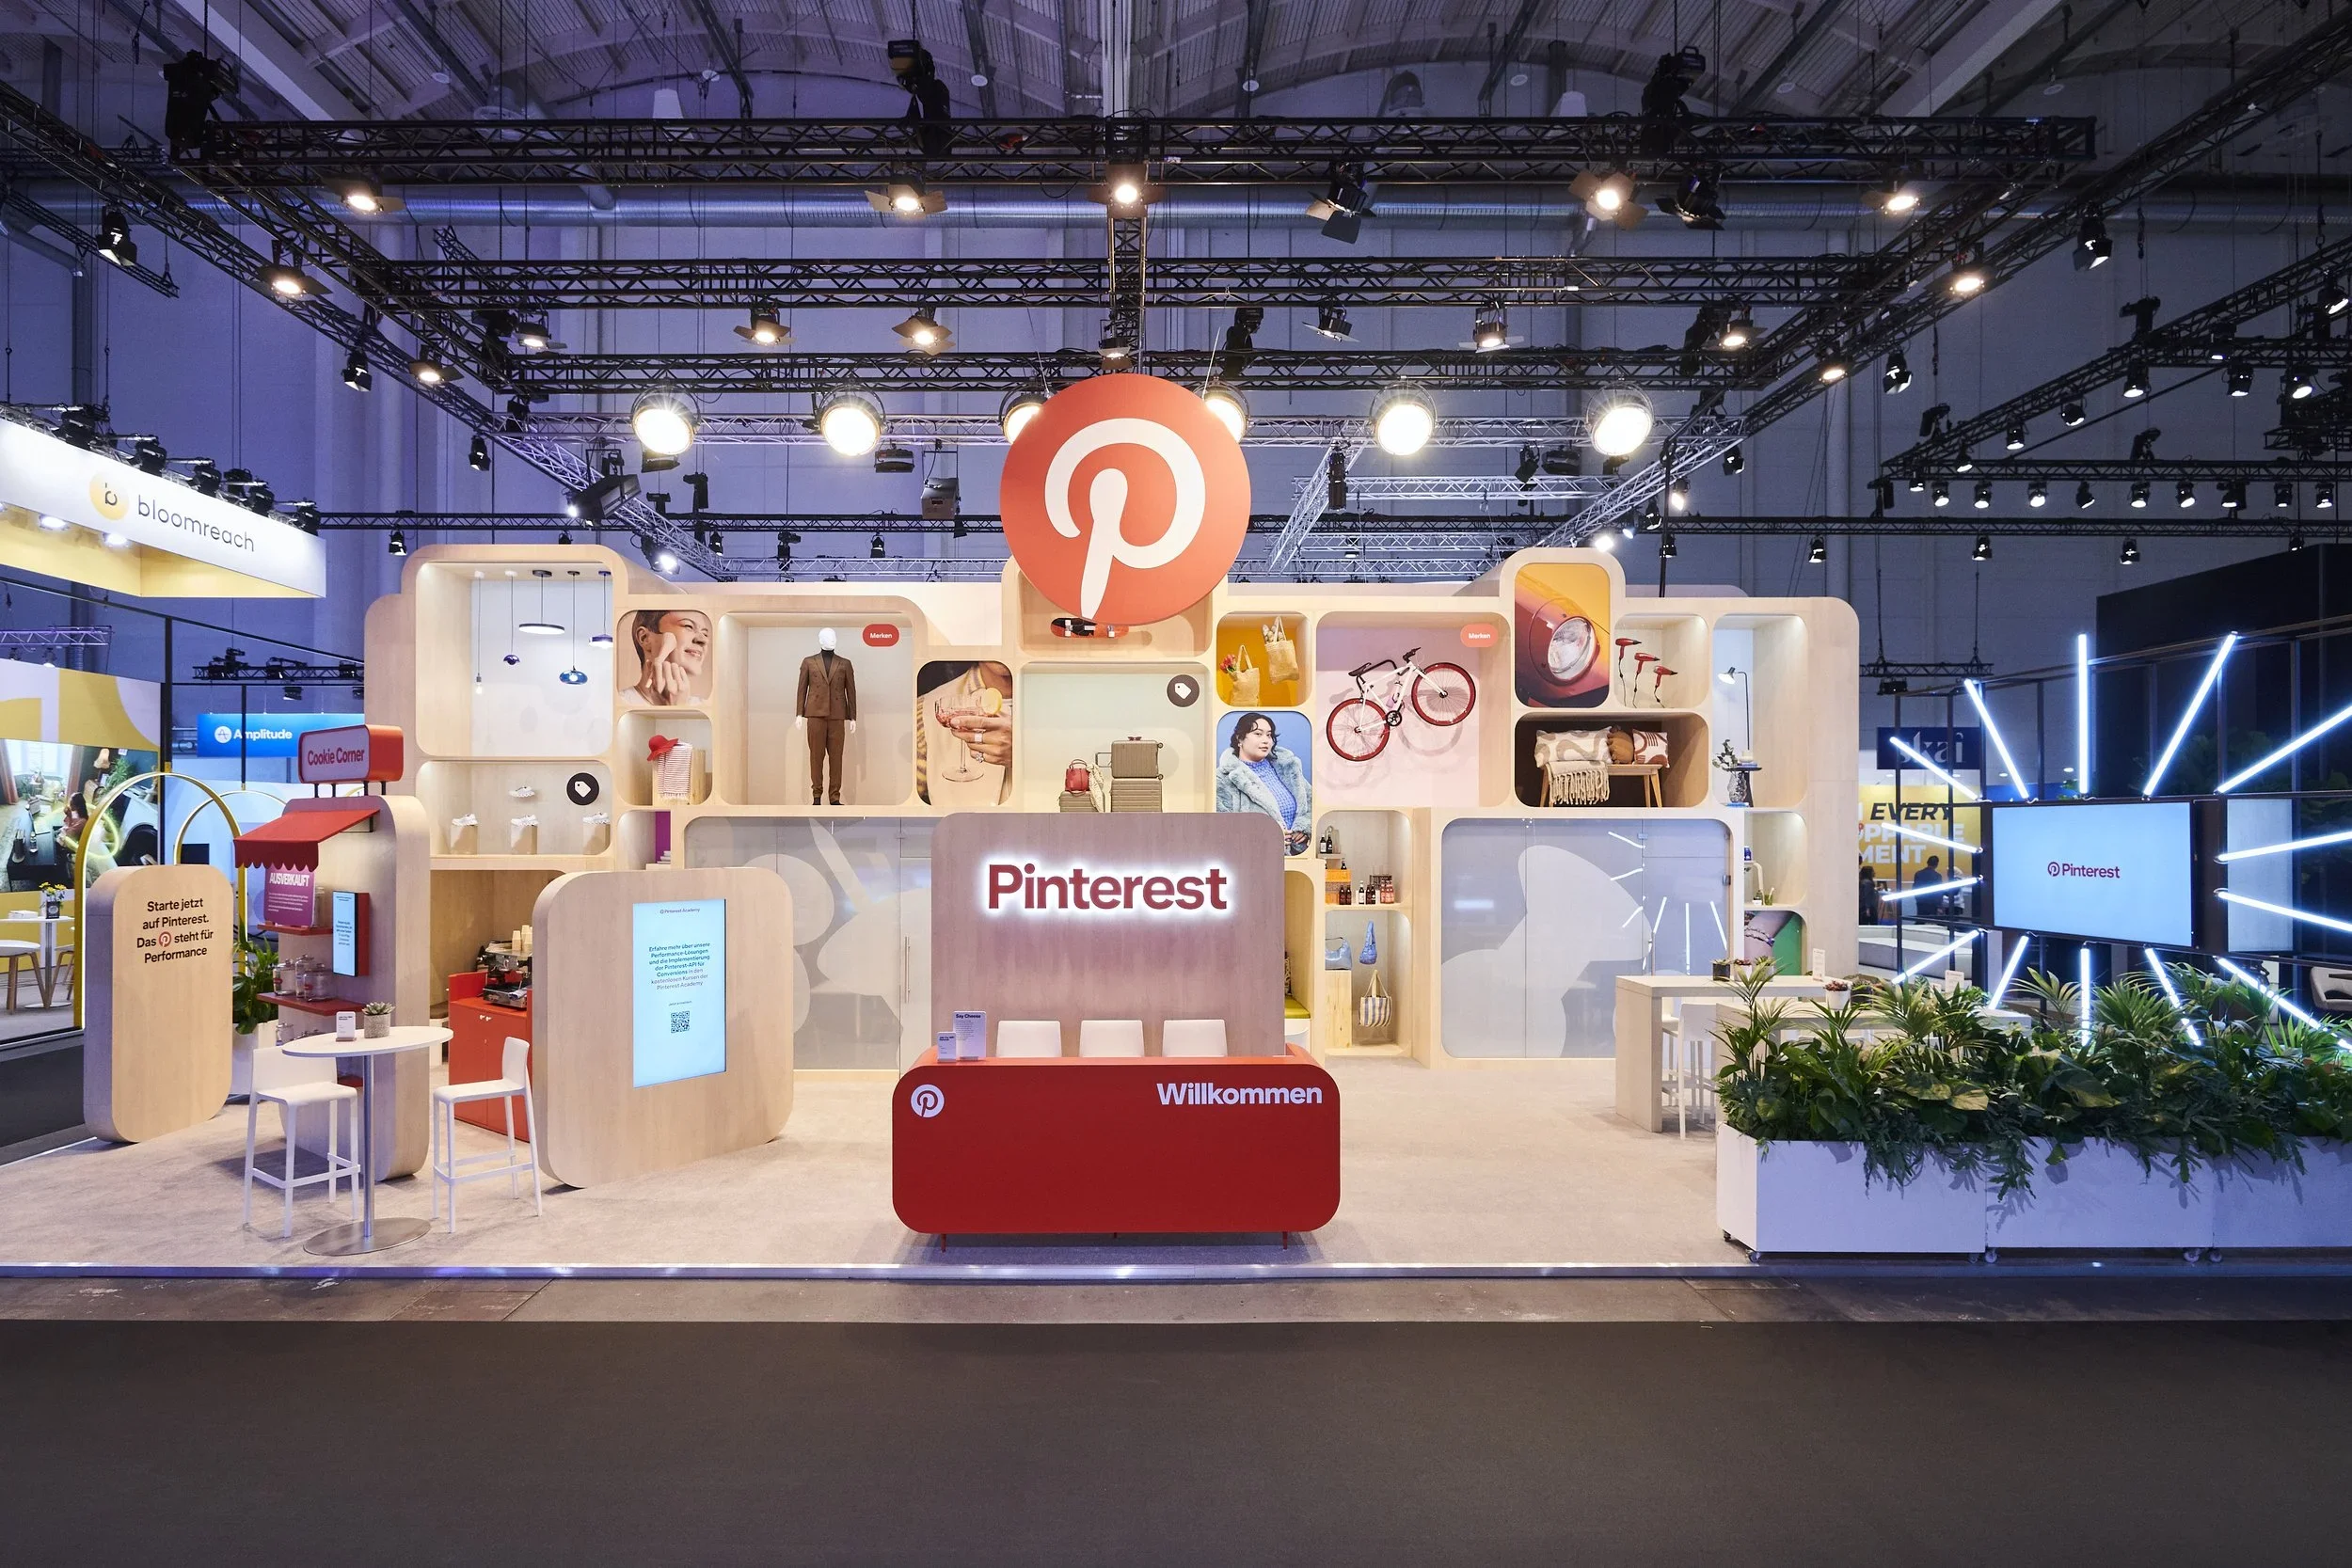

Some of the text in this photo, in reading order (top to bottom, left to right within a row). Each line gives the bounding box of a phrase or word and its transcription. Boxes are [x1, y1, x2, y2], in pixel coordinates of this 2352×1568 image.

[138, 494, 255, 552] bloomreach
[233, 728, 293, 741] Amplitude
[307, 747, 365, 766] Cookie Corner
[1870, 803, 1950, 820] EVERY
[2062, 863, 2121, 879] Pinterest
[269, 873, 310, 887] AUSVERKAUFT
[989, 863, 1228, 910] Pinterest
[147, 898, 203, 912] Starte jetzt
[143, 914, 209, 929] auf Pinterest.
[137, 937, 156, 948] Das
[174, 931, 199, 942] steht
[200, 929, 214, 940] für
[145, 947, 207, 963] Performance
[669, 955, 710, 963] Implementierung
[1156, 1082, 1323, 1105] Willkommen
